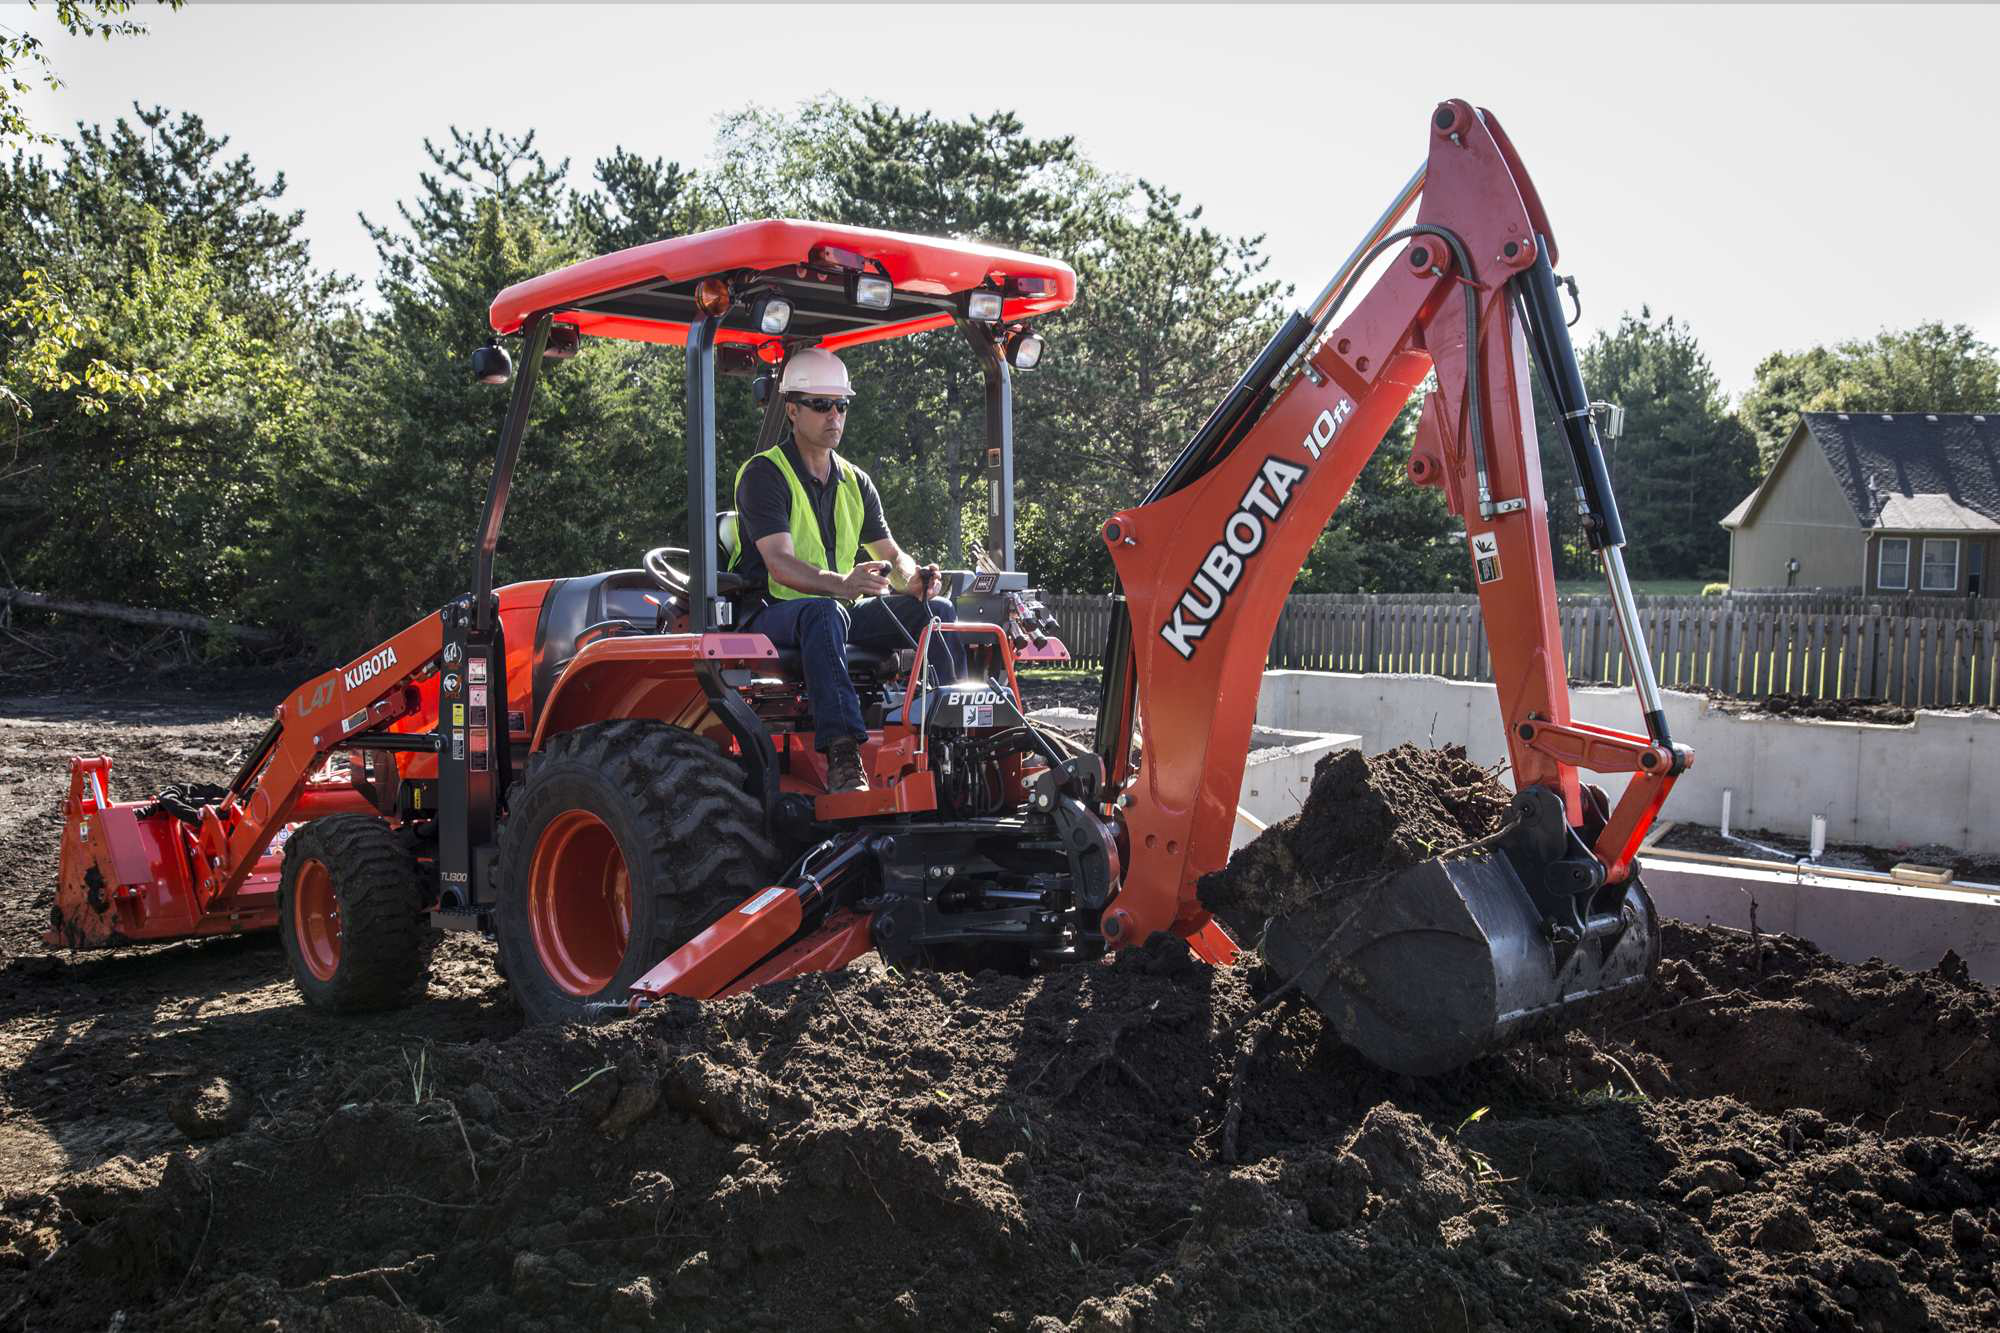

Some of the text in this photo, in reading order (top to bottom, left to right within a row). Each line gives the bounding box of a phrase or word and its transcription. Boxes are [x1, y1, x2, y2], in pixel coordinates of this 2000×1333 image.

[1303, 399, 1351, 460] 10ft
[1160, 457, 1306, 659] KUBOTA
[344, 646, 397, 691] KUBOTA
[296, 678, 337, 717] L47
[440, 871, 468, 882] TL1300
